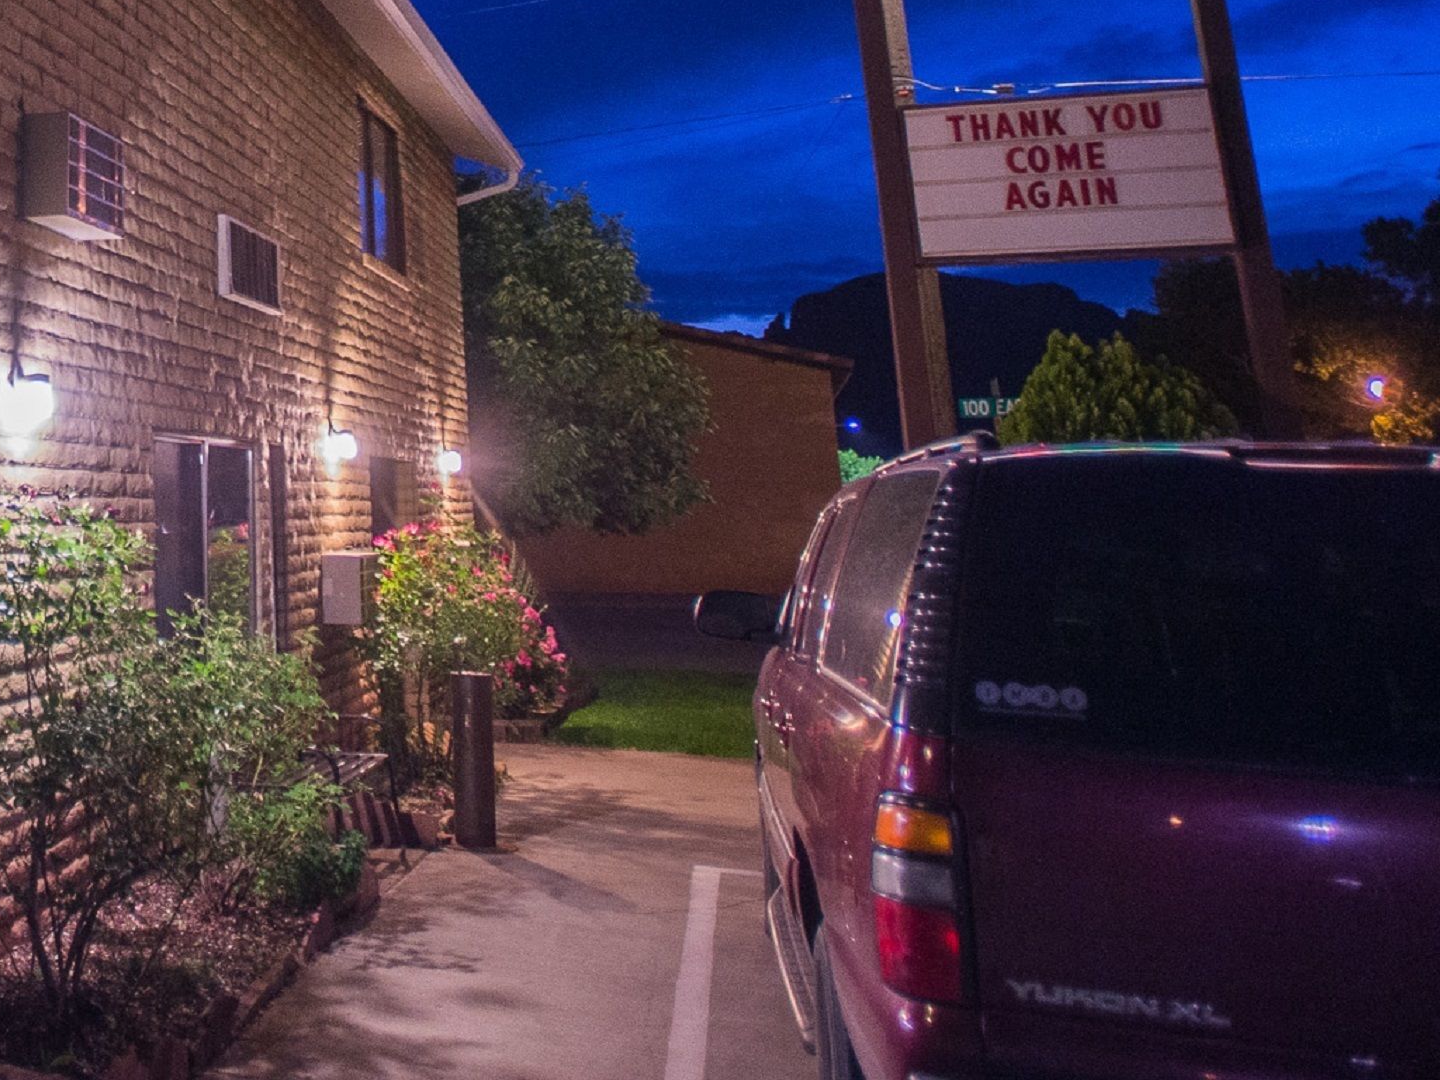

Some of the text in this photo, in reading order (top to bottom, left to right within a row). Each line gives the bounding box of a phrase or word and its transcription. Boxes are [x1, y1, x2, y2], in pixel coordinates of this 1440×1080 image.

[945, 100, 1165, 143] THANK YOU
[1004, 141, 1107, 174] COME
[1004, 176, 1119, 211] AGAIN
[962, 397, 1021, 416] 100 EA
[1005, 977, 1232, 1029] YUKON XL
